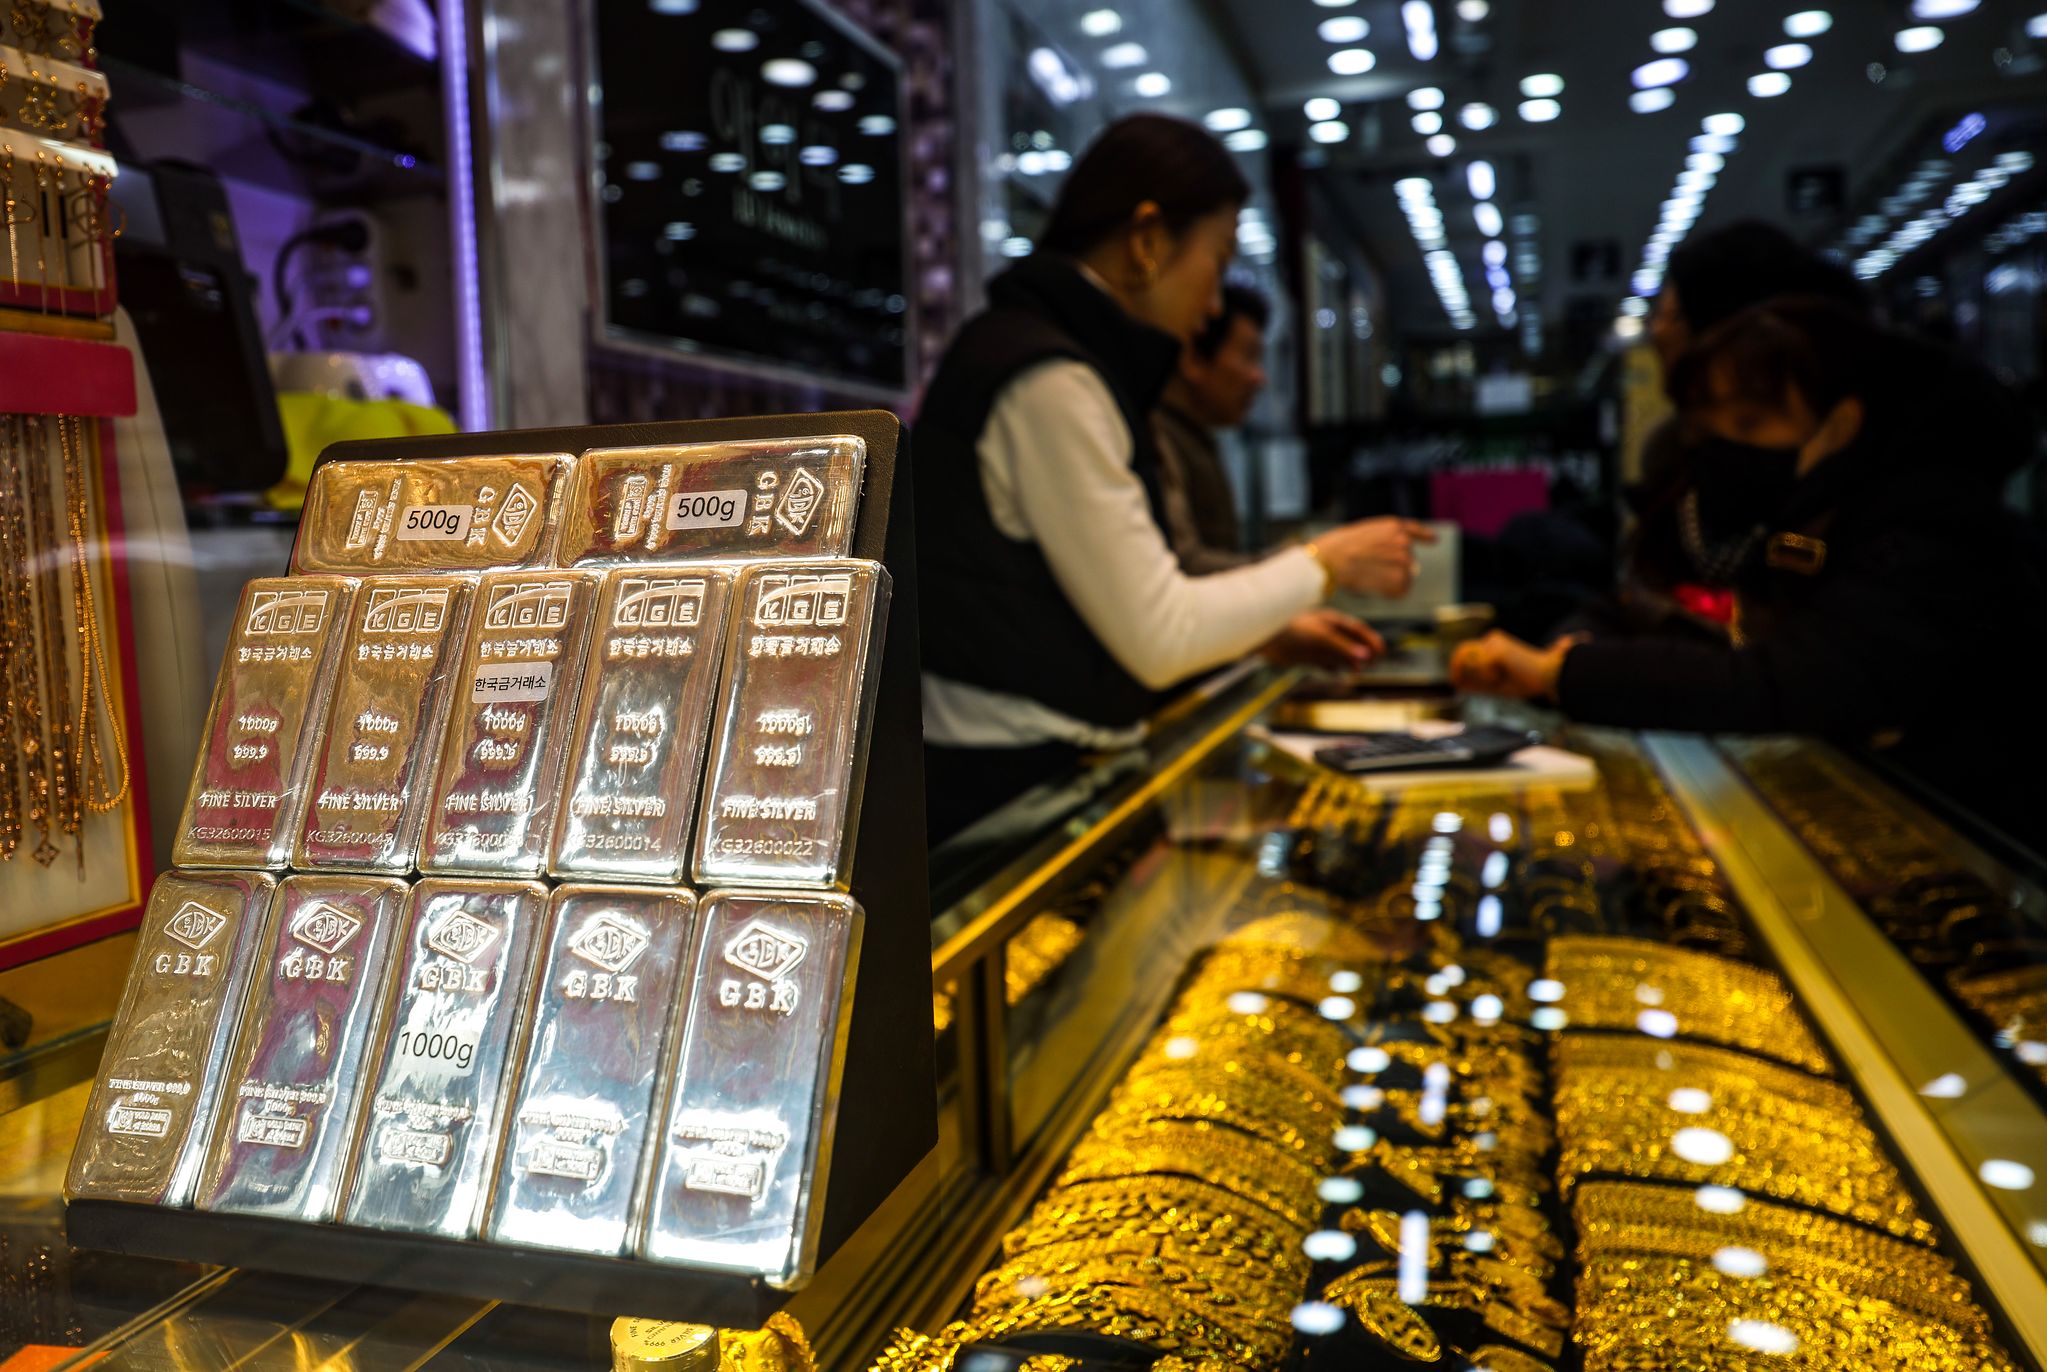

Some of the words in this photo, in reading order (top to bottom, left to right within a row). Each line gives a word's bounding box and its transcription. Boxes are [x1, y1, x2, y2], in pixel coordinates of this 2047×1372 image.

[677, 495, 735, 522] 500g
[749, 471, 778, 536] GBK
[406, 509, 461, 535] 500g
[466, 486, 496, 547] GBK
[371, 611, 437, 628] KGE
[493, 606, 561, 625] KGE
[622, 602, 694, 622] KGE
[763, 600, 840, 620] KGE
[253, 614, 316, 630] KGE
[238, 645, 313, 662] 한국금거래소
[357, 643, 434, 661] 한국금거래소
[480, 638, 559, 658] 한국금거래소
[475, 675, 546, 692] 한국금거래소
[239, 714, 279, 733] 1000g
[358, 713, 399, 734] 1000g
[233, 745, 270, 760] 999.9
[353, 744, 389, 761] 999.9
[200, 793, 230, 808] FINE
[233, 794, 277, 809] SILVER
[318, 793, 350, 810] FINE
[353, 794, 399, 811] SILVER
[446, 796, 477, 811] FINE
[480, 796, 530, 813] SILVER
[574, 797, 608, 815] FINE
[612, 798, 663, 817] SILVER
[722, 801, 757, 819] FINE
[760, 801, 816, 821] SILVER
[155, 952, 214, 976] GBK
[284, 955, 349, 981] GBK
[421, 966, 489, 993] GBK
[565, 971, 639, 1002] GBK
[719, 980, 793, 1012] GBK
[401, 1032, 473, 1069] 1000g
